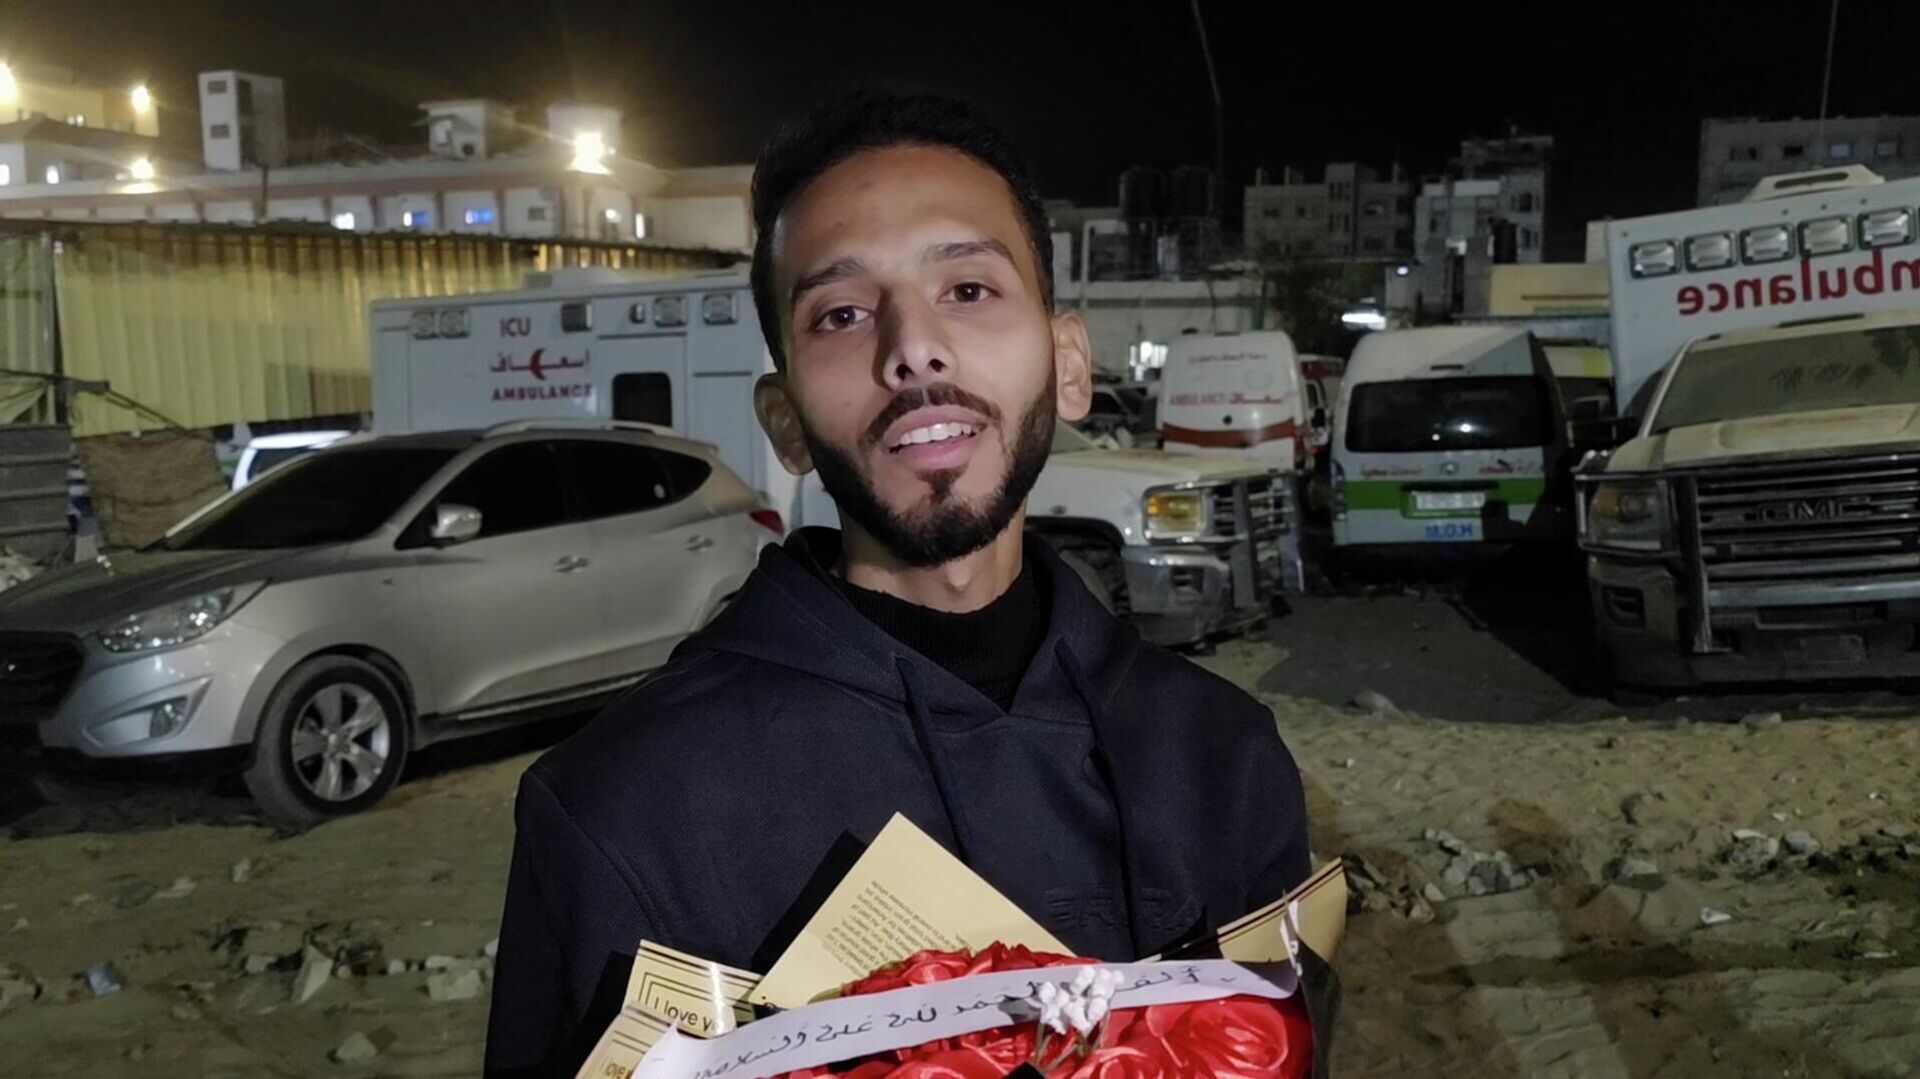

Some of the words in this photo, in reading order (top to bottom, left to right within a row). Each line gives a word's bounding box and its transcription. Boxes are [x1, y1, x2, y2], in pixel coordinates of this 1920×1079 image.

[500, 317, 531, 337] ICU
[492, 384, 592, 401] AMBULANCE
[664, 999, 699, 1026] love
